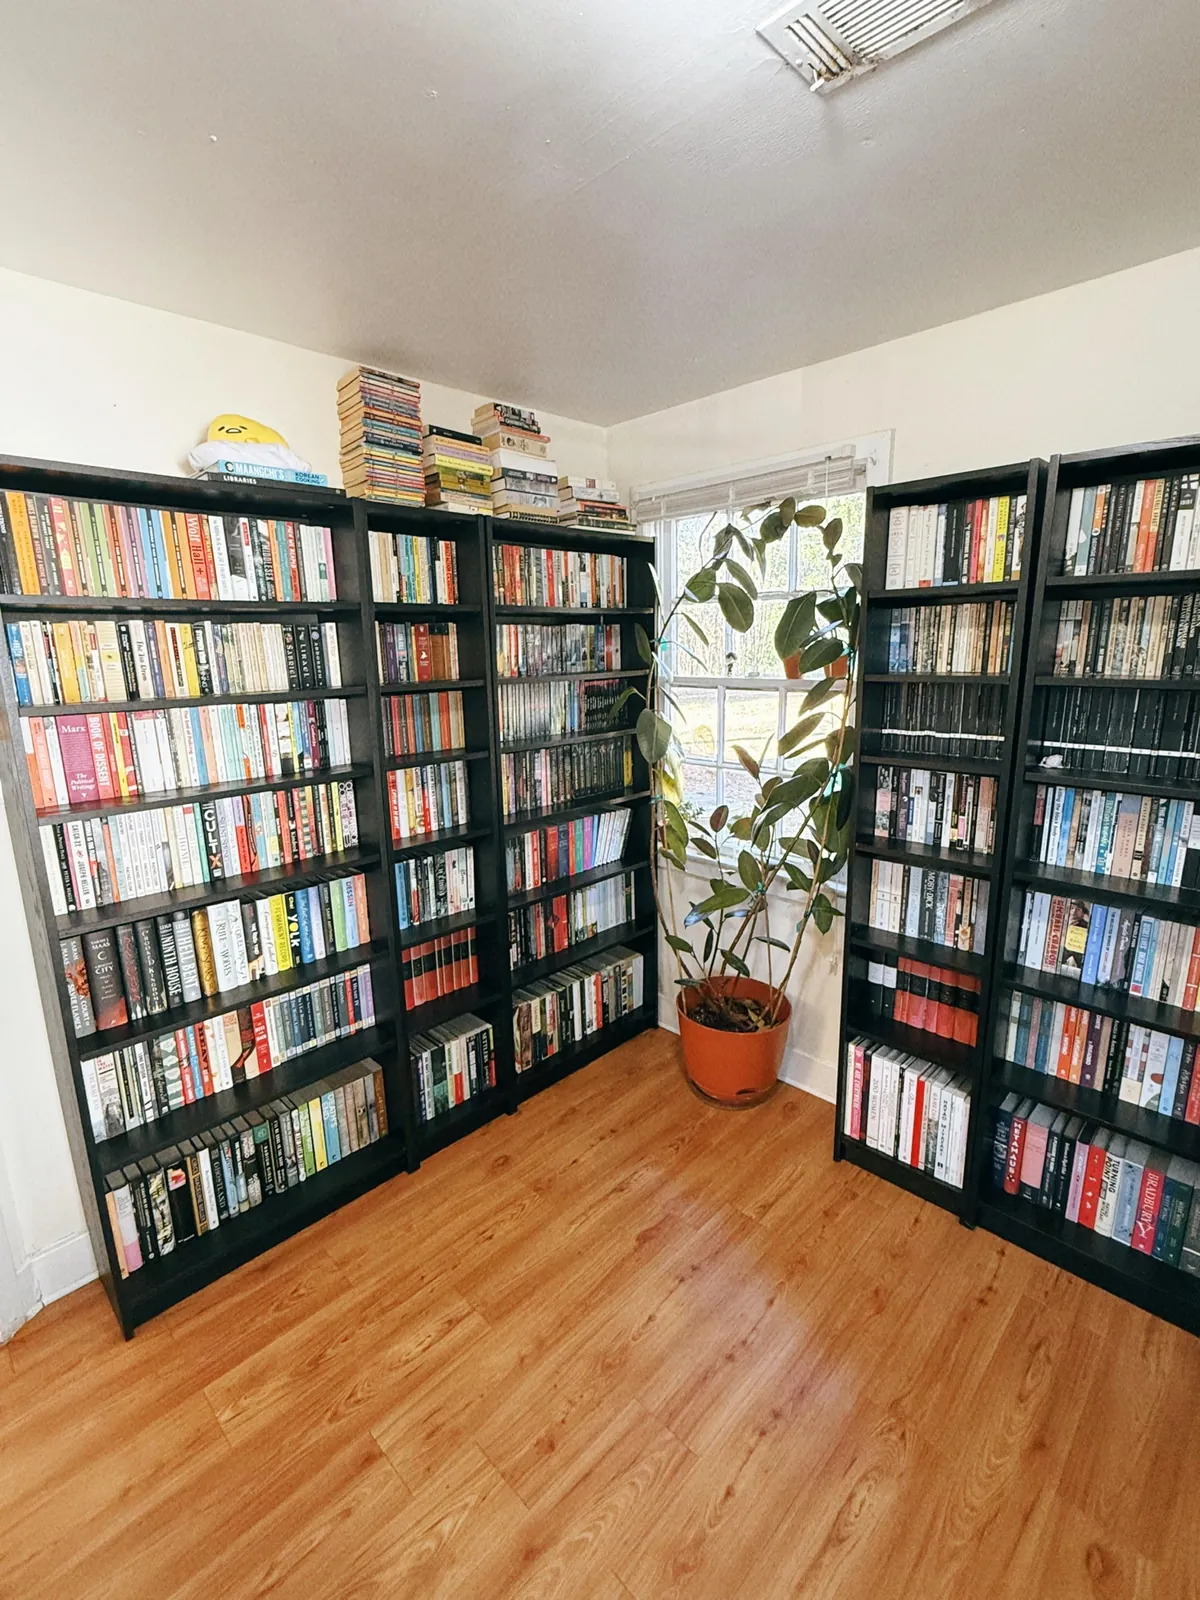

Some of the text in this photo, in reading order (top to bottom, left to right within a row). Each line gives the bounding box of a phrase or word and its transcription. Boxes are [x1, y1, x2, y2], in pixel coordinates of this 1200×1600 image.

[223, 475, 257, 485] LIBRARIES
[235, 462, 285, 480] MAANGCHI'S
[188, 517, 200, 542] Wolf
[1151, 512, 1159, 527] APART
[192, 545, 203, 565] Hall
[263, 545, 273, 581] MIDDLESEX
[286, 644, 297, 678] SABRIEL
[300, 644, 310, 678] LIRAEL
[89, 717, 110, 786] BOOK OF DISSENT
[72, 824, 81, 847] CATCH-22
[204, 810, 217, 854] CULT
[81, 880, 90, 896] HELLER
[345, 881, 354, 907] DESSEN
[925, 871, 936, 909] MOBY-DICK
[1053, 900, 1064, 933] MICHAEL
[1121, 918, 1131, 937] Angela
[275, 907, 288, 963] PERMANENT RECORD
[1048, 935, 1060, 965] CHABON
[61, 948, 69, 965] MAAS
[95, 965, 113, 974] CITY
[161, 934, 182, 996] NINTH HOUSE
[177, 936, 198, 989] HELL BENT
[72, 1005, 82, 1030] FLAMES
[80, 1001, 90, 1020] COURT
[328, 1094, 336, 1128] DEATH'S
[939, 1124, 947, 1156] MIYAZAKI
[1008, 1122, 1022, 1174] METAMAUS
[1104, 1156, 1112, 1180] POINT
[1108, 1160, 1120, 1193] TURNING
[213, 1161, 226, 1208] GHOSTLAND
[1140, 1173, 1159, 1225] BRADBURY
